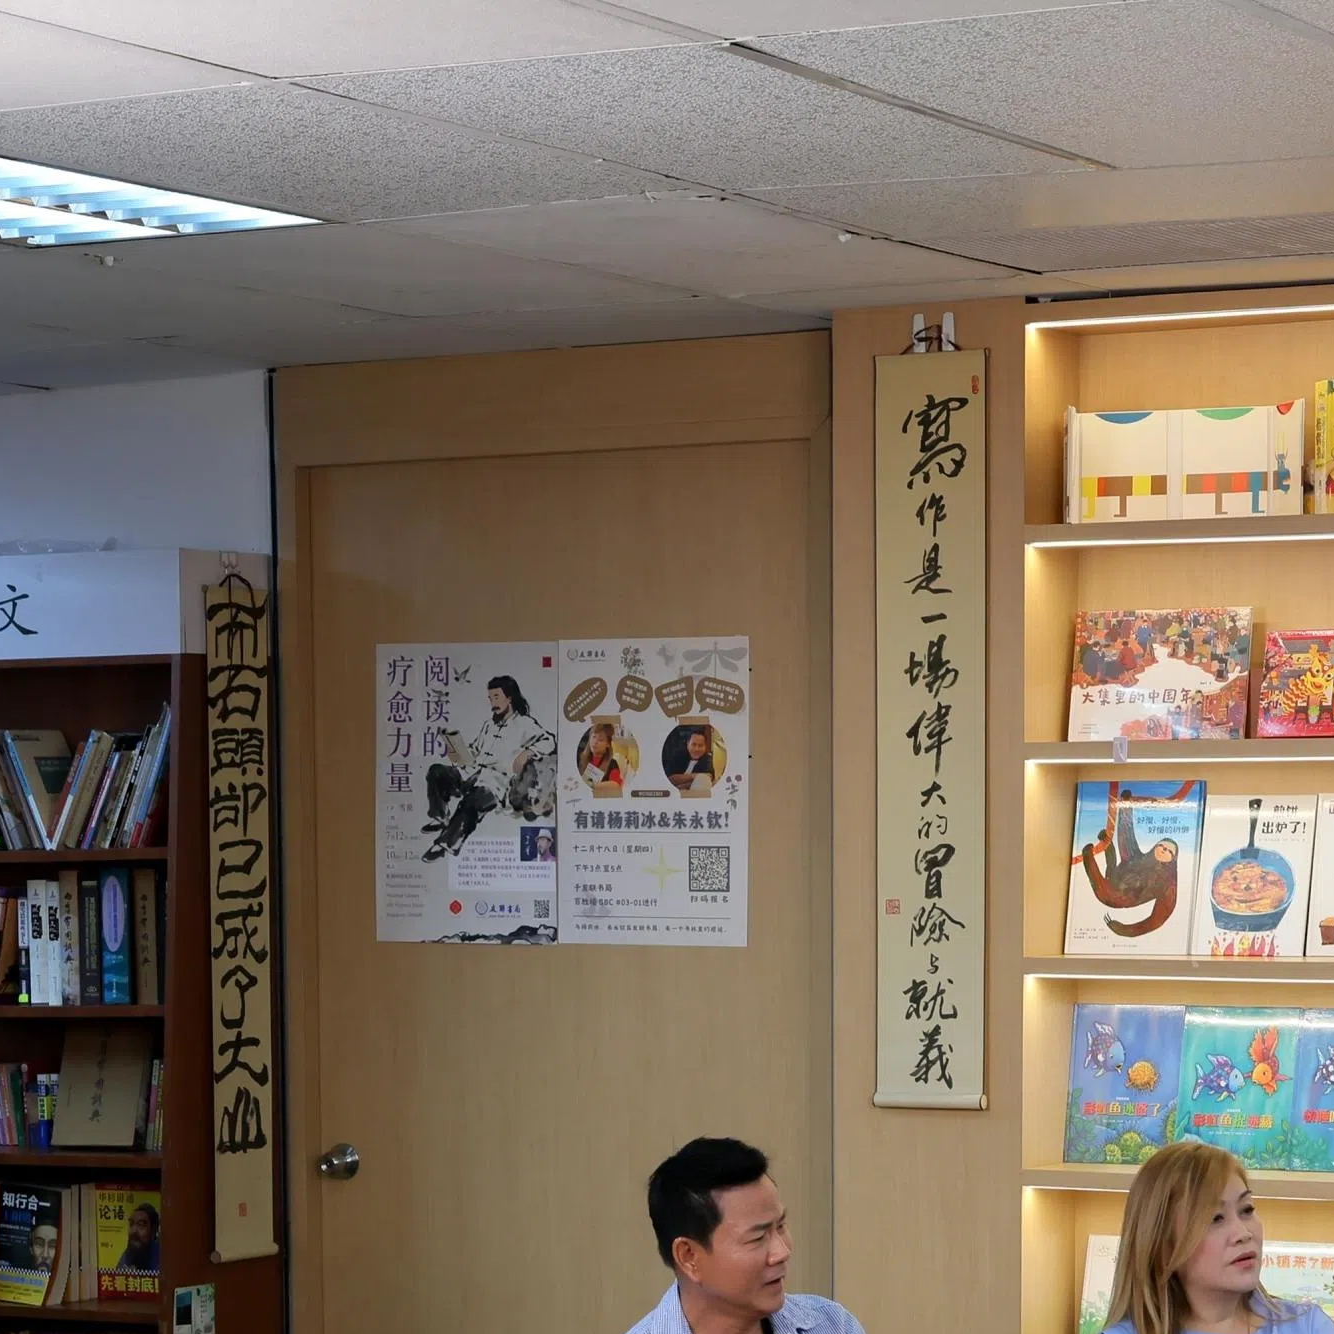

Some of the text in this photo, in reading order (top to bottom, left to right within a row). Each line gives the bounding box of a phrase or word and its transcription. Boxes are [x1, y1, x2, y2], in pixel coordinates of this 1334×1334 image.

[1082, 687, 1194, 706] 大集里的中国年
[422, 655, 451, 759] 阅读的
[385, 655, 415, 794] 疗愈力量
[2, 1191, 52, 1212] 知行合一
[99, 1204, 126, 1221] 论语
[100, 1275, 160, 1294] 先看封底!
